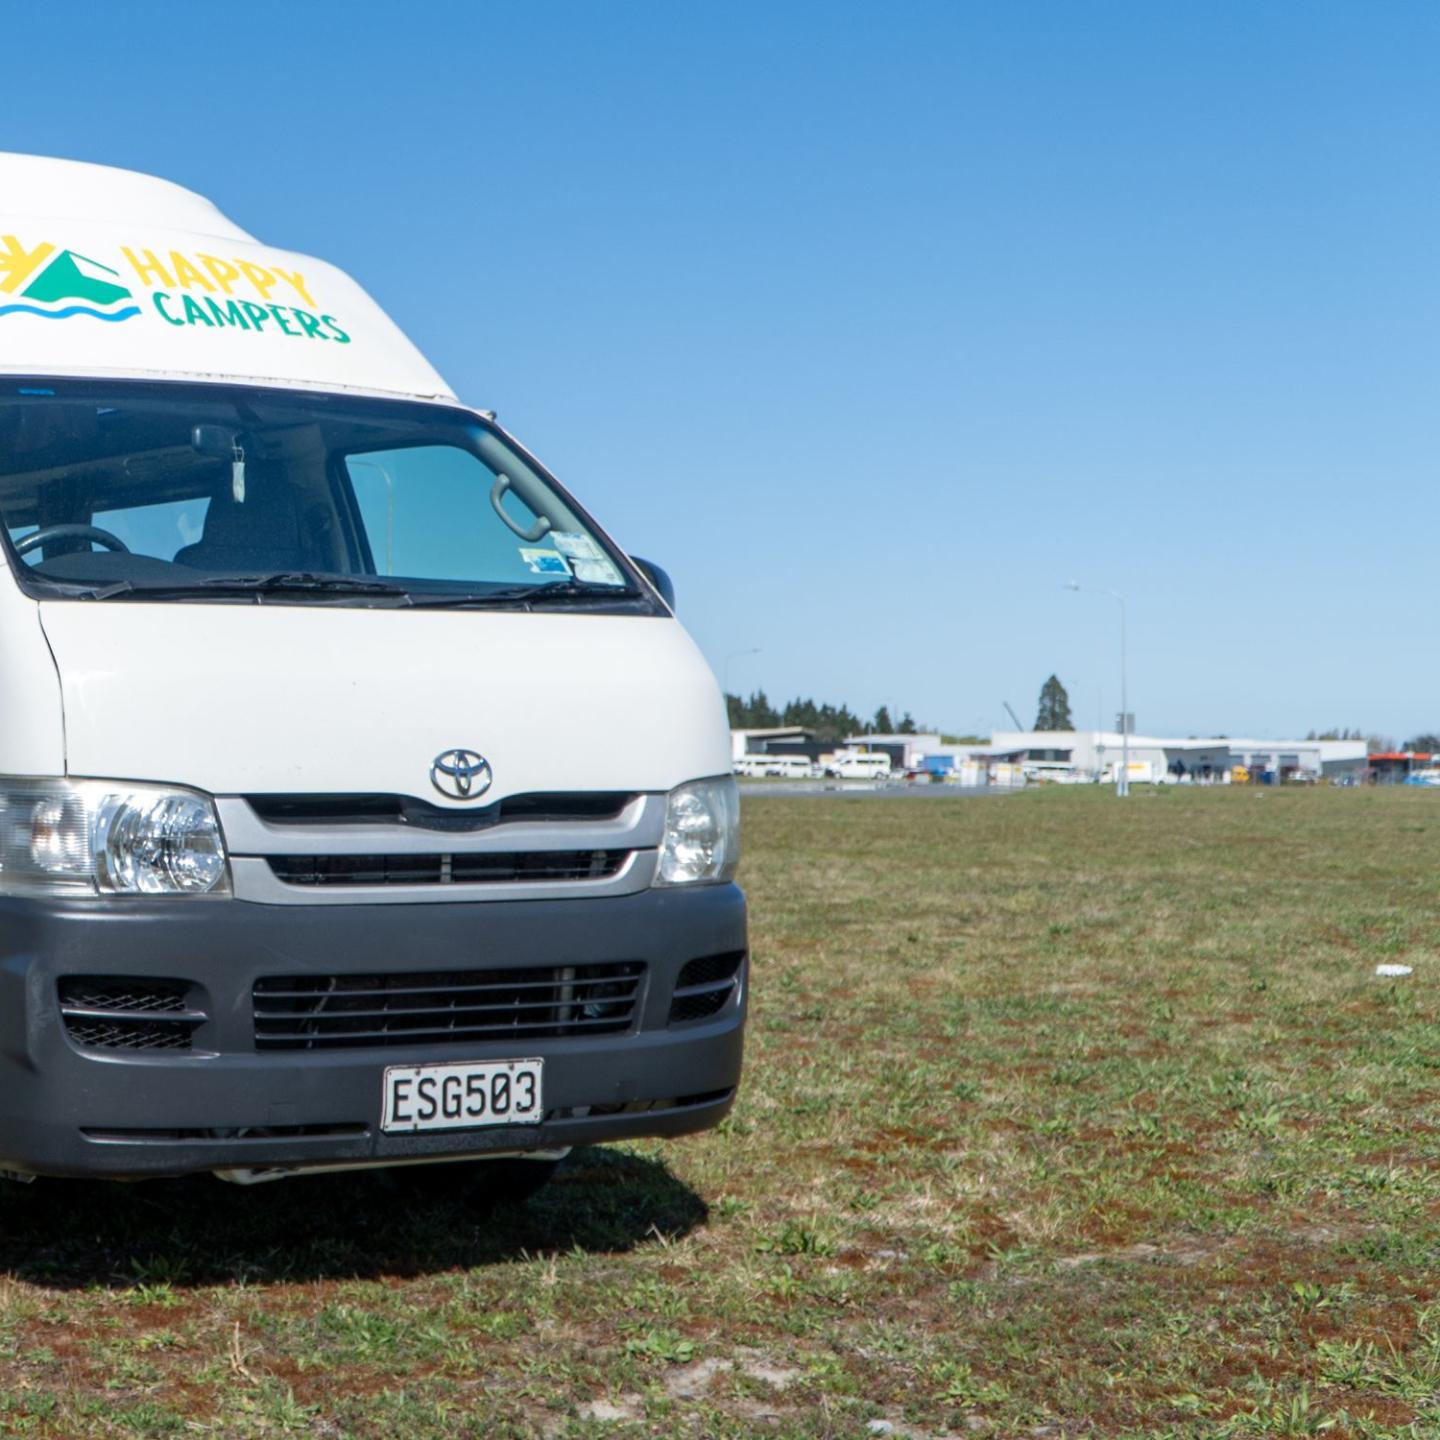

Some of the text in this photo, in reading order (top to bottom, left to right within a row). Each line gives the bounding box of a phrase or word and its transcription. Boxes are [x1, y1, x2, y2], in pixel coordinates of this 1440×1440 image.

[120, 246, 318, 309] HAPPY
[151, 291, 351, 344] CAMPERS
[392, 1071, 536, 1123] ESG503
